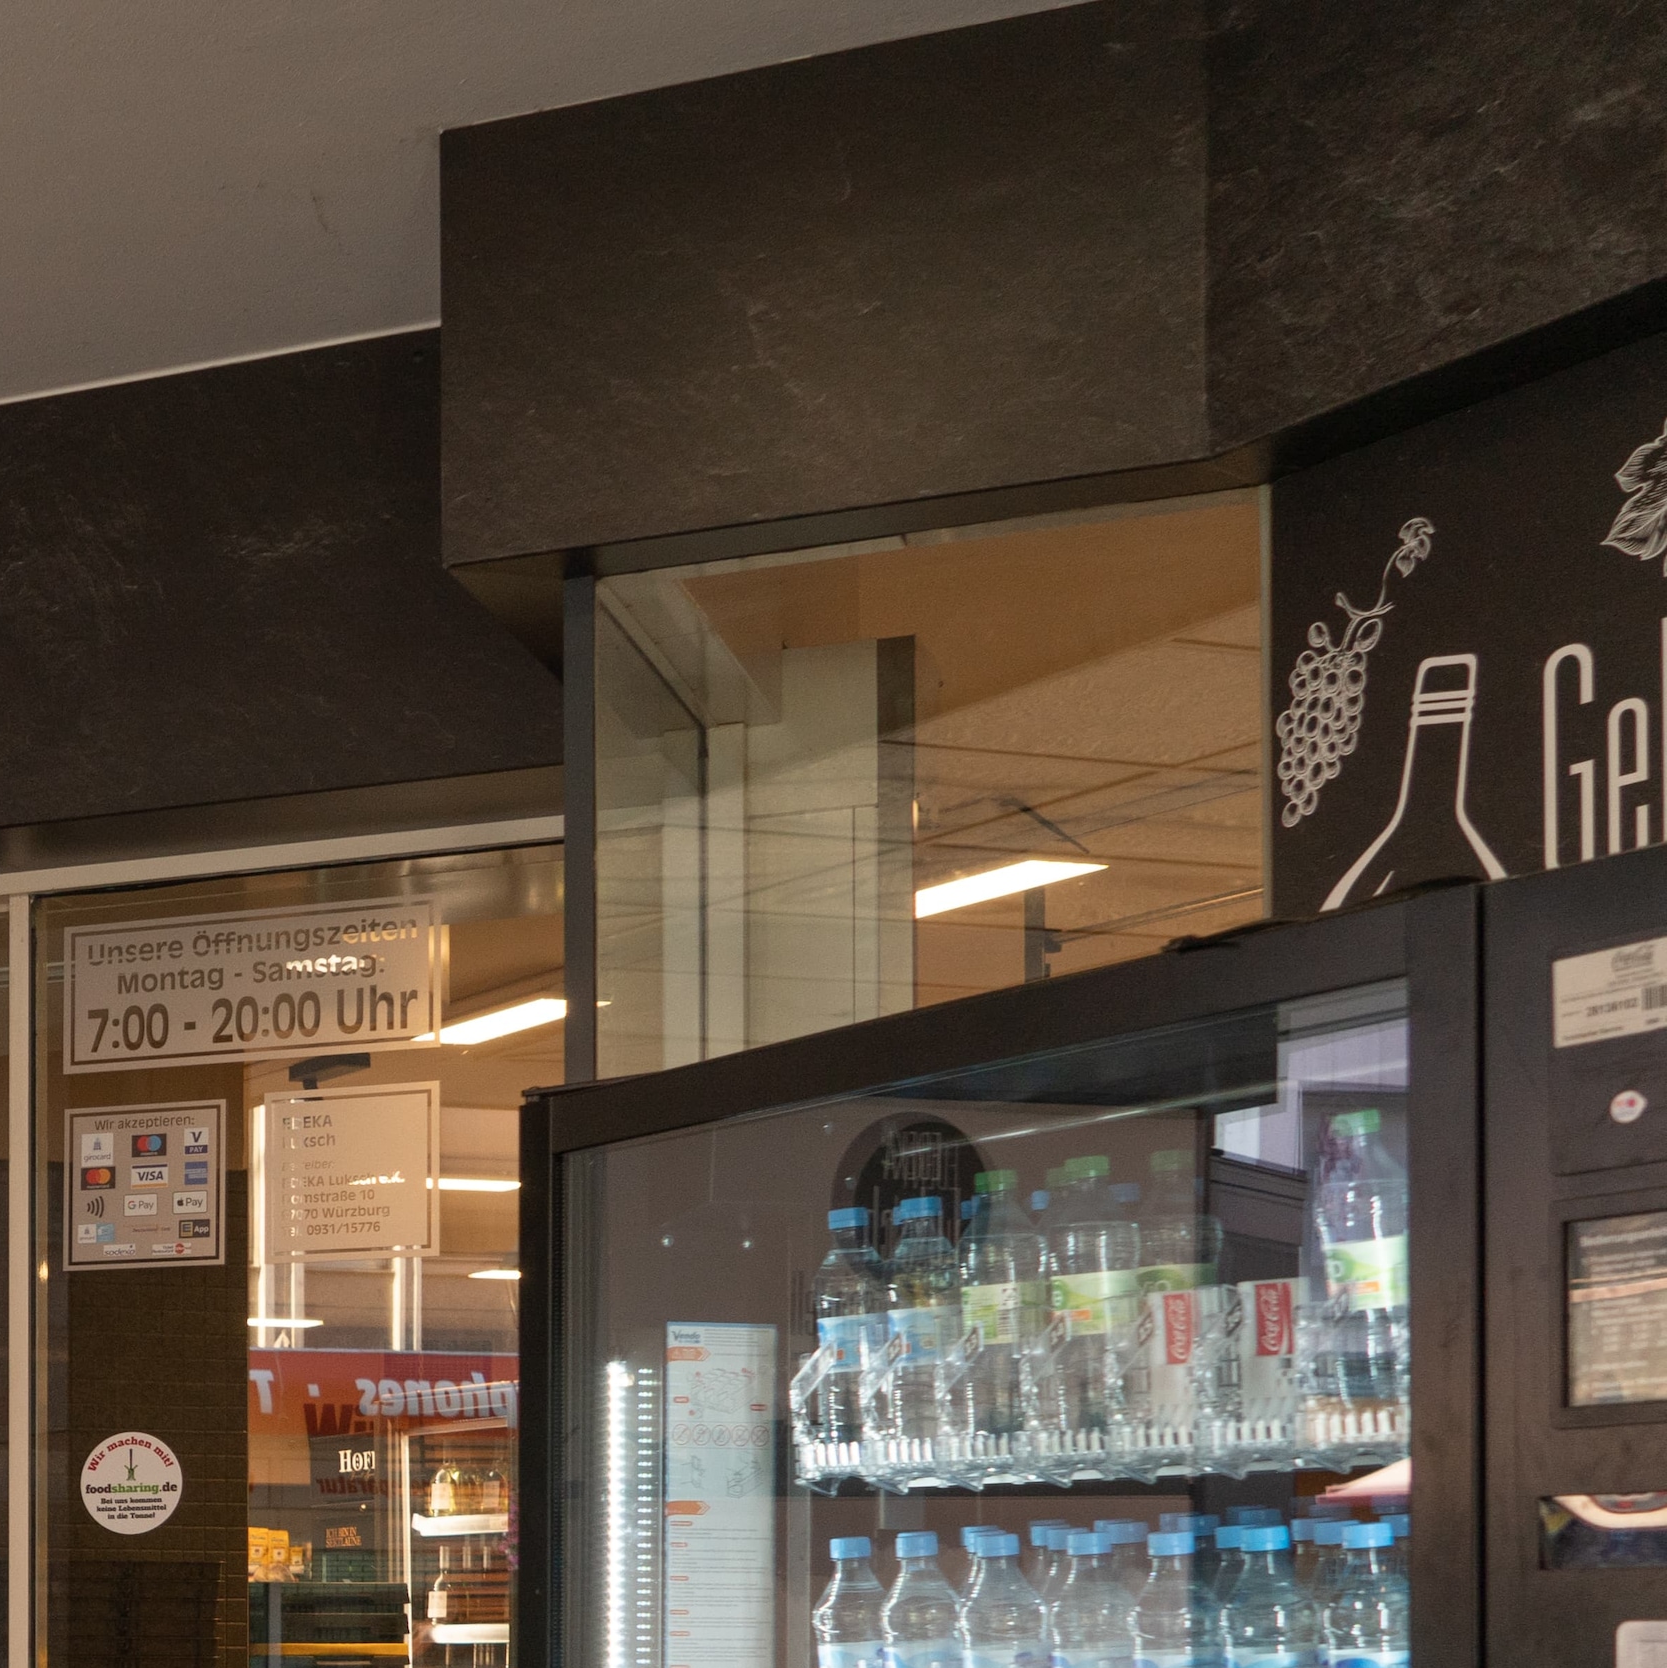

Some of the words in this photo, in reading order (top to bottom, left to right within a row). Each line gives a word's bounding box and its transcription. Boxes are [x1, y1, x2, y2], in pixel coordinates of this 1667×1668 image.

[1543, 616, 1667, 870] Ge
[87, 936, 184, 967] Unsere
[191, 917, 418, 957] Öffnungszeiten
[117, 964, 224, 994] Montag
[87, 1002, 170, 1053] 7:00
[211, 990, 322, 1044] 20:00
[335, 984, 419, 1035] Uhr
[94, 1119, 115, 1131] Wir
[117, 1115, 195, 1130] akzeptieren:
[83, 1153, 112, 1163] girocard
[135, 1170, 164, 1182] VISA
[359, 1188, 375, 1201] 10
[138, 1200, 155, 1211] Pay
[185, 1197, 204, 1208] Pay
[321, 1205, 391, 1219] Würzburg
[193, 1225, 210, 1235] App
[306, 1220, 381, 1236] 0931/15776
[87, 1450, 106, 1472] Wir
[106, 1436, 152, 1453] machen
[153, 1446, 175, 1468] mit!
[85, 1481, 178, 1495] foodsharing.de
[118, 1504, 167, 1512] Lebensmittel
